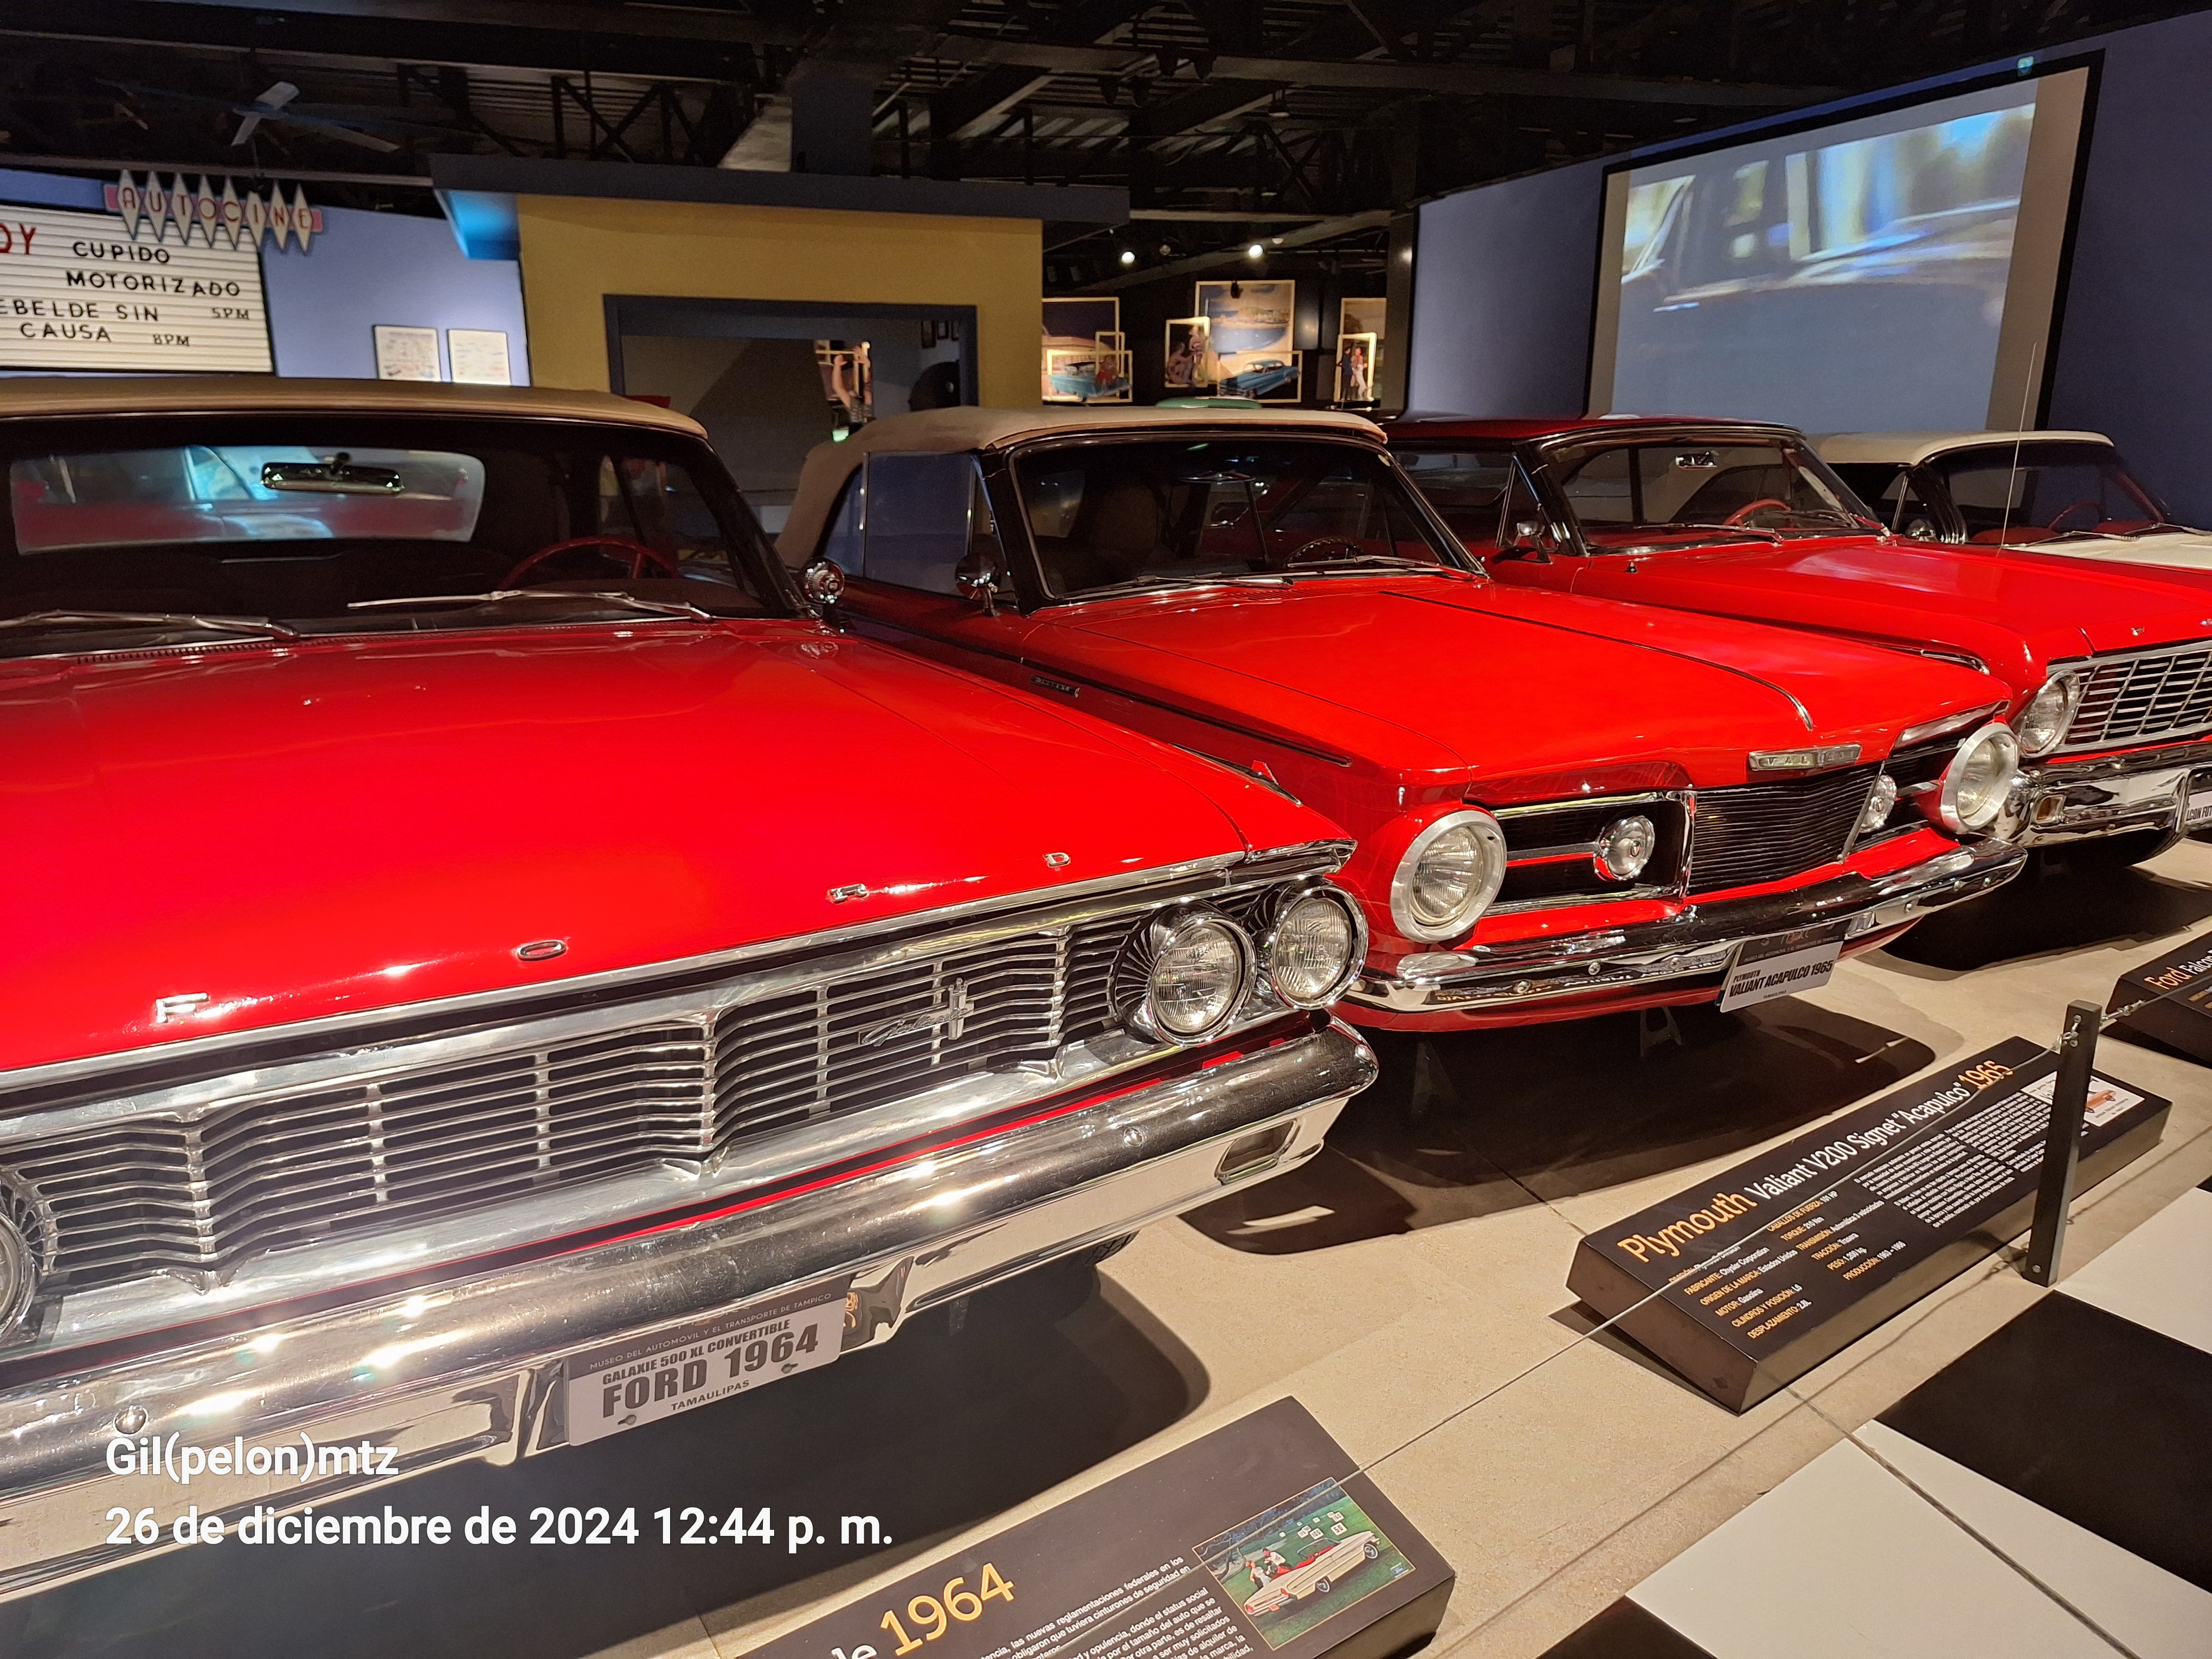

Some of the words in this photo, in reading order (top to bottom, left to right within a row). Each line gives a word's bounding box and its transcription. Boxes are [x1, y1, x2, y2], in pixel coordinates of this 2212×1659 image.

[123, 187, 311, 229] AUTOCINE
[73, 241, 170, 264] CUPIDO
[66, 270, 240, 297] MOTORIZADO
[116, 305, 159, 321] SIN
[211, 307, 250, 320] 5PM
[20, 323, 112, 343] CAUSA
[153, 333, 190, 346] 8PM
[1729, 977, 1766, 997] VALIANT
[1764, 965, 1811, 988] ACAPULCO
[1811, 960, 1834, 976] 1965
[2143, 967, 2194, 990] Ford
[1618, 1193, 1756, 1261] Plymouth
[1744, 1163, 1817, 1199] Valiant
[1802, 1141, 1857, 1169] V200
[1847, 1118, 1906, 1148] Signet
[1957, 1060, 2013, 1086] 1965
[1700, 1289, 1725, 1305] ORIGEN
[1720, 1284, 1734, 1294] DE
[590, 1355, 623, 1370] MUSEO
[627, 1349, 642, 1359] DEL
[712, 1325, 722, 1333] EL
[725, 1308, 777, 1329] TRANSPORTE
[781, 1303, 791, 1313] DE
[794, 1293, 832, 1308] TAMPICO
[603, 1359, 658, 1385] GALAXIE
[660, 1351, 687, 1367] 500
[690, 1345, 705, 1359] XL
[708, 1319, 790, 1353] CONVERTIBLE
[603, 1359, 708, 1418] FORD
[724, 1323, 819, 1378] 1964
[671, 1379, 750, 1411] TAMAULIPAS
[1332, 1523, 1344, 1534] 50
[880, 1562, 1014, 1656] 1964
[1010, 1638, 1025, 1649] las
[1025, 1622, 1056, 1641] nuevas
[1056, 1587, 1124, 1625] reglamentaciones
[1123, 1569, 1159, 1590] federales
[1159, 1563, 1171, 1572] en
[1169, 1557, 1184, 1566] los
[1012, 1638, 1050, 1659] obligaron
[1050, 1630, 1066, 1642] que
[1065, 1616, 1094, 1633] tuviera
[1093, 1595, 1133, 1619] cinturones
[1133, 1590, 1144, 1599] de
[1143, 1569, 1180, 1593] seguridad
[1179, 1565, 1191, 1574] en
[1082, 1650, 1090, 1659] y
[1090, 1631, 1131, 1655] opulencia,
[1129, 1617, 1155, 1633] donde
[1154, 1610, 1163, 1620] el
[1162, 1600, 1186, 1616] status
[1185, 1586, 1208, 1604] social
[1107, 1647, 1121, 1659] por
[1121, 1641, 1131, 1651] el
[1129, 1628, 1160, 1646] tamaño
[1159, 1618, 1173, 1630] del
[1172, 1611, 1191, 1624] auto
[1189, 1603, 1205, 1614] que
[1204, 1597, 1216, 1606] se
[1135, 1645, 1153, 1657] otra
[1150, 1634, 1175, 1650] parte,
[1174, 1627, 1185, 1636] es
[1184, 1622, 1195, 1631] de
[1194, 1606, 1222, 1625] resaltar
[1159, 1647, 1172, 1658] ser
[1172, 1637, 1190, 1651] muy
[1189, 1616, 1230, 1641] solicitados
[1187, 1647, 1199, 1656] de
[1199, 1631, 1226, 1650] alquiler
[1226, 1625, 1237, 1635] de
[1209, 1641, 1237, 1658] marca,
[1234, 1635, 1246, 1643] la
